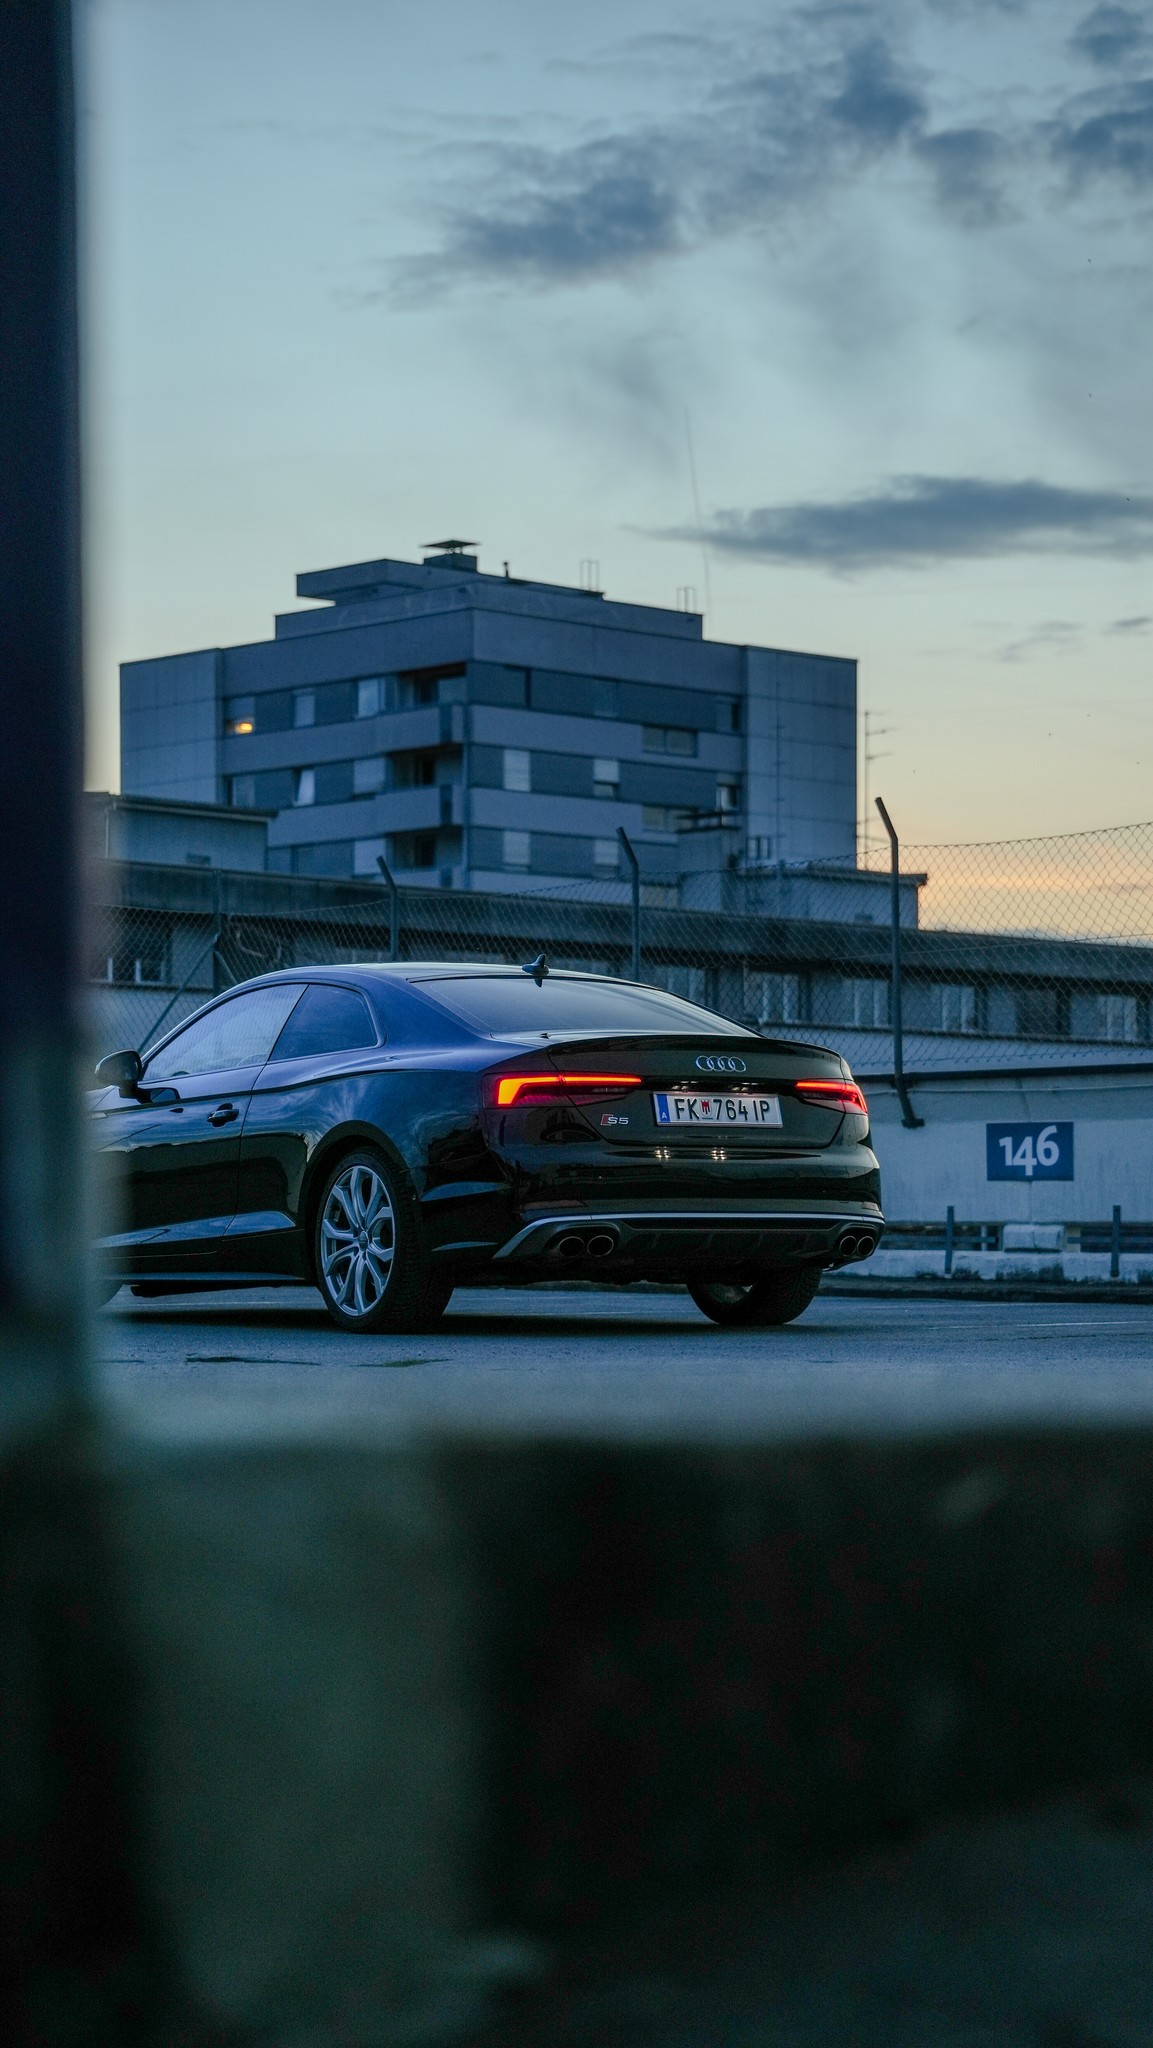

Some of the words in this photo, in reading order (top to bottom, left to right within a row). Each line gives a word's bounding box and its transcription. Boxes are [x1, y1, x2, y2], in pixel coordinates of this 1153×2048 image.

[674, 1099, 699, 1120] FK
[607, 1116, 629, 1125] S5
[998, 1124, 1060, 1176] 146
